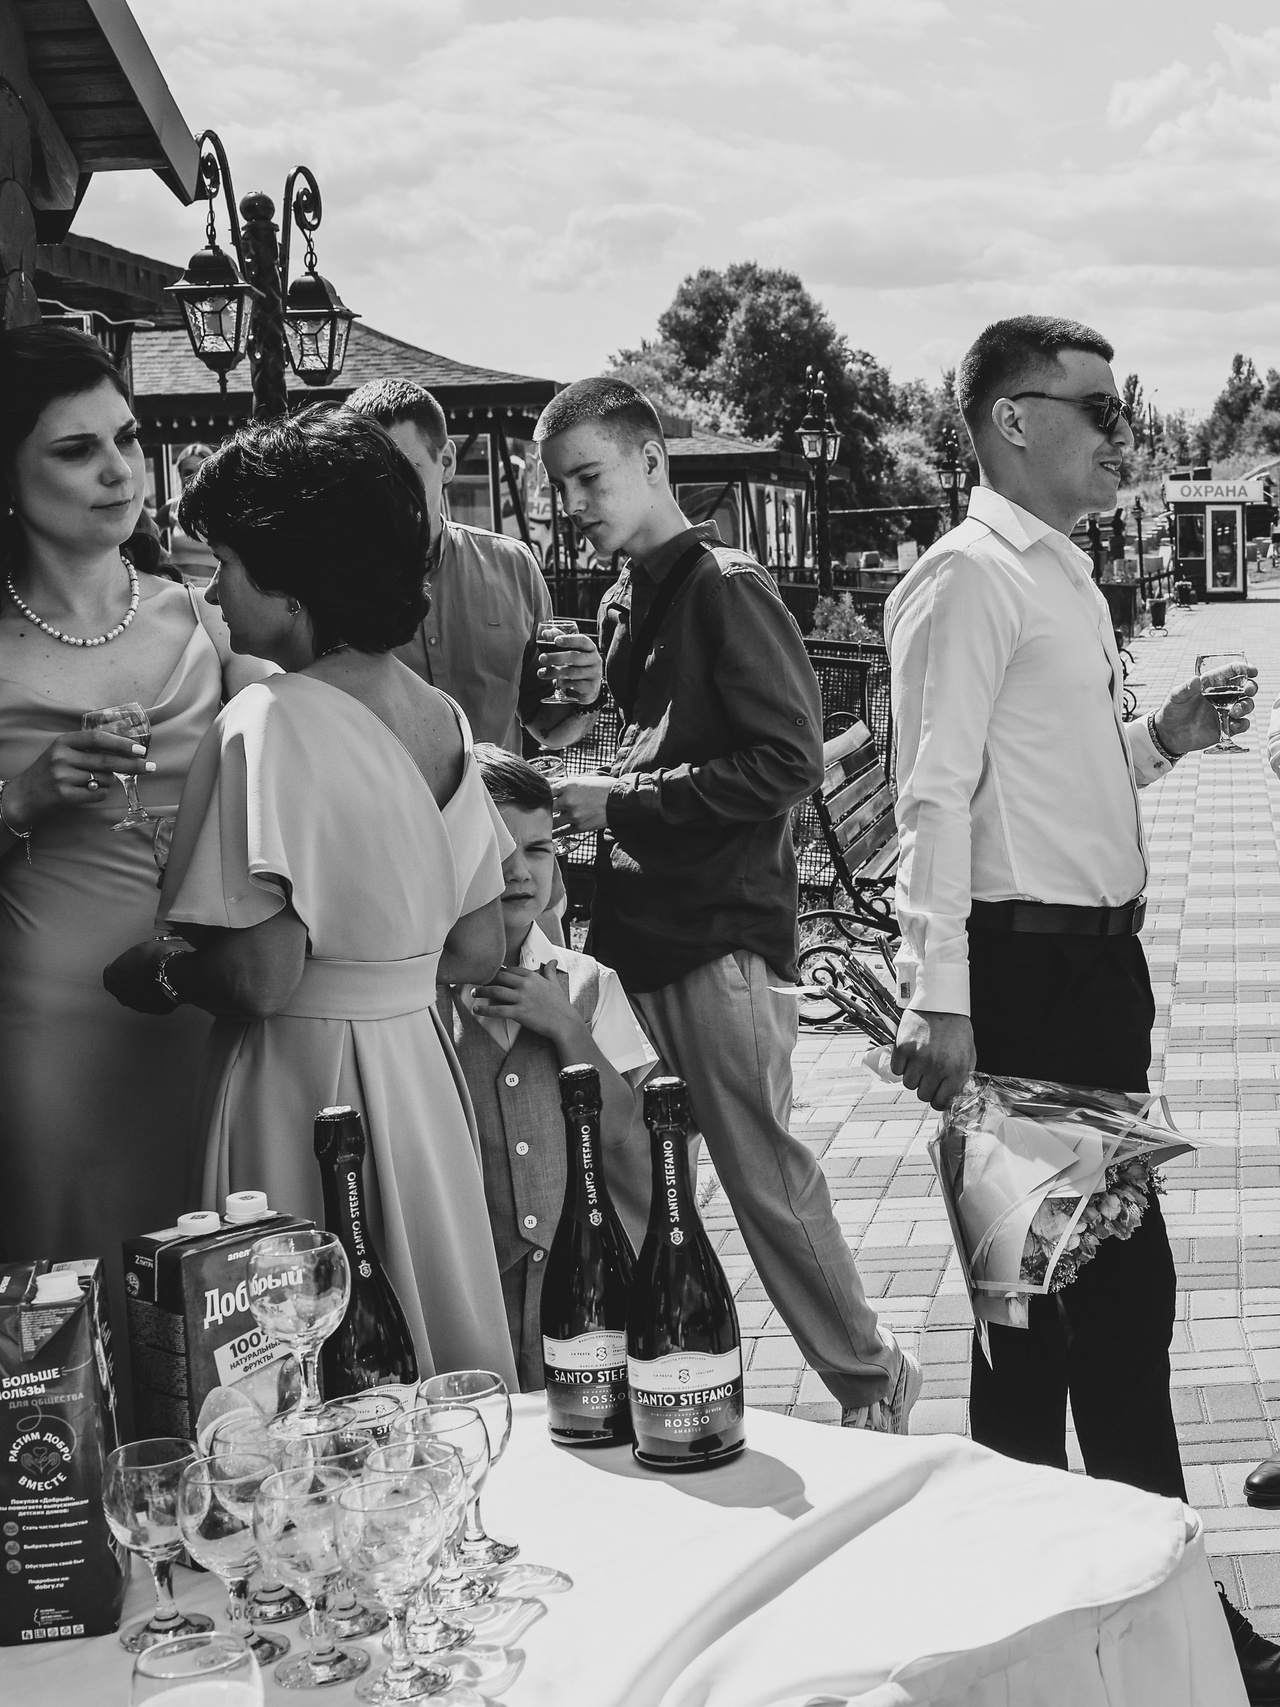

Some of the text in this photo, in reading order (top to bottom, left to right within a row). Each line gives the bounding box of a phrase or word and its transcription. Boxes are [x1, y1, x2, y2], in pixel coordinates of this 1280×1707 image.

[1180, 485, 1248, 497] ОХРАНА
[581, 1125, 597, 1204] SANTO STEFANO
[663, 1141, 680, 1222] SANTO STEFANO
[347, 1172, 366, 1255] SANTO STEFANO
[229, 1341, 281, 1371] НАТУРАЛЬНЫ
[243, 1353, 274, 1372] ФРУКТЫ
[2, 1368, 60, 1388] БОЛЬШЕ
[554, 1368, 628, 1383] SANTO STEF
[9, 1392, 84, 1409] ДЛЯ ОБЩЕСТВА
[637, 1384, 733, 1407] SANTO STEFANO
[664, 1415, 710, 1428] ROSSO
[9, 1432, 72, 1462] РАСТИМ ДОБРО
[18, 1472, 67, 1491] ВМЕСТЕ
[34, 1582, 64, 1590] dobry.ru
